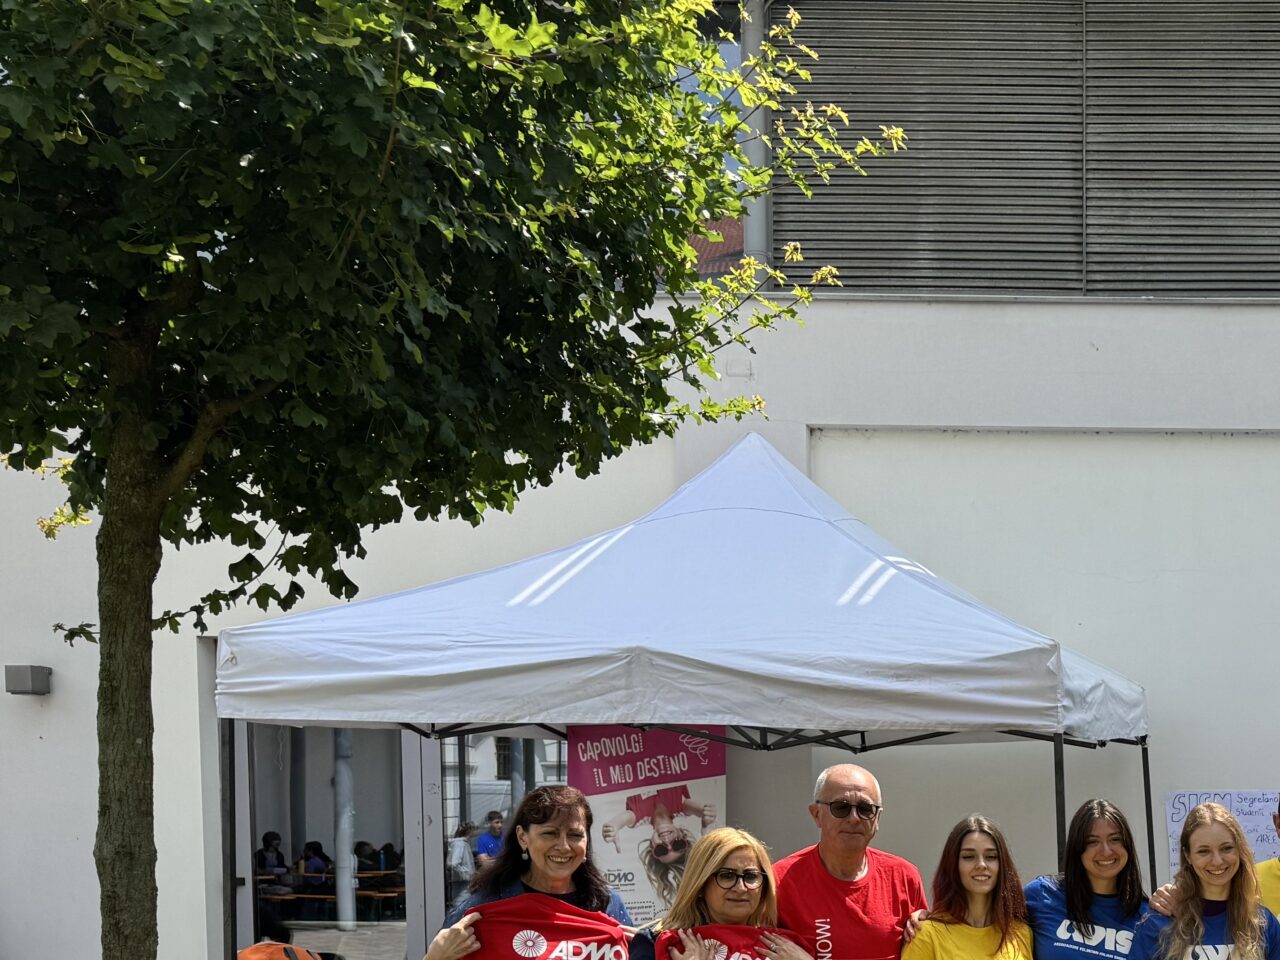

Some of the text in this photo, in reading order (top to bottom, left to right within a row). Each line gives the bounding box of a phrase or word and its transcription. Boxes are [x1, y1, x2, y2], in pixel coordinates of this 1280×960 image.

[577, 733, 644, 763] CAPOVOLGI
[593, 751, 689, 788] IL MIO DESTINO
[1056, 918, 1134, 955] AVIS
